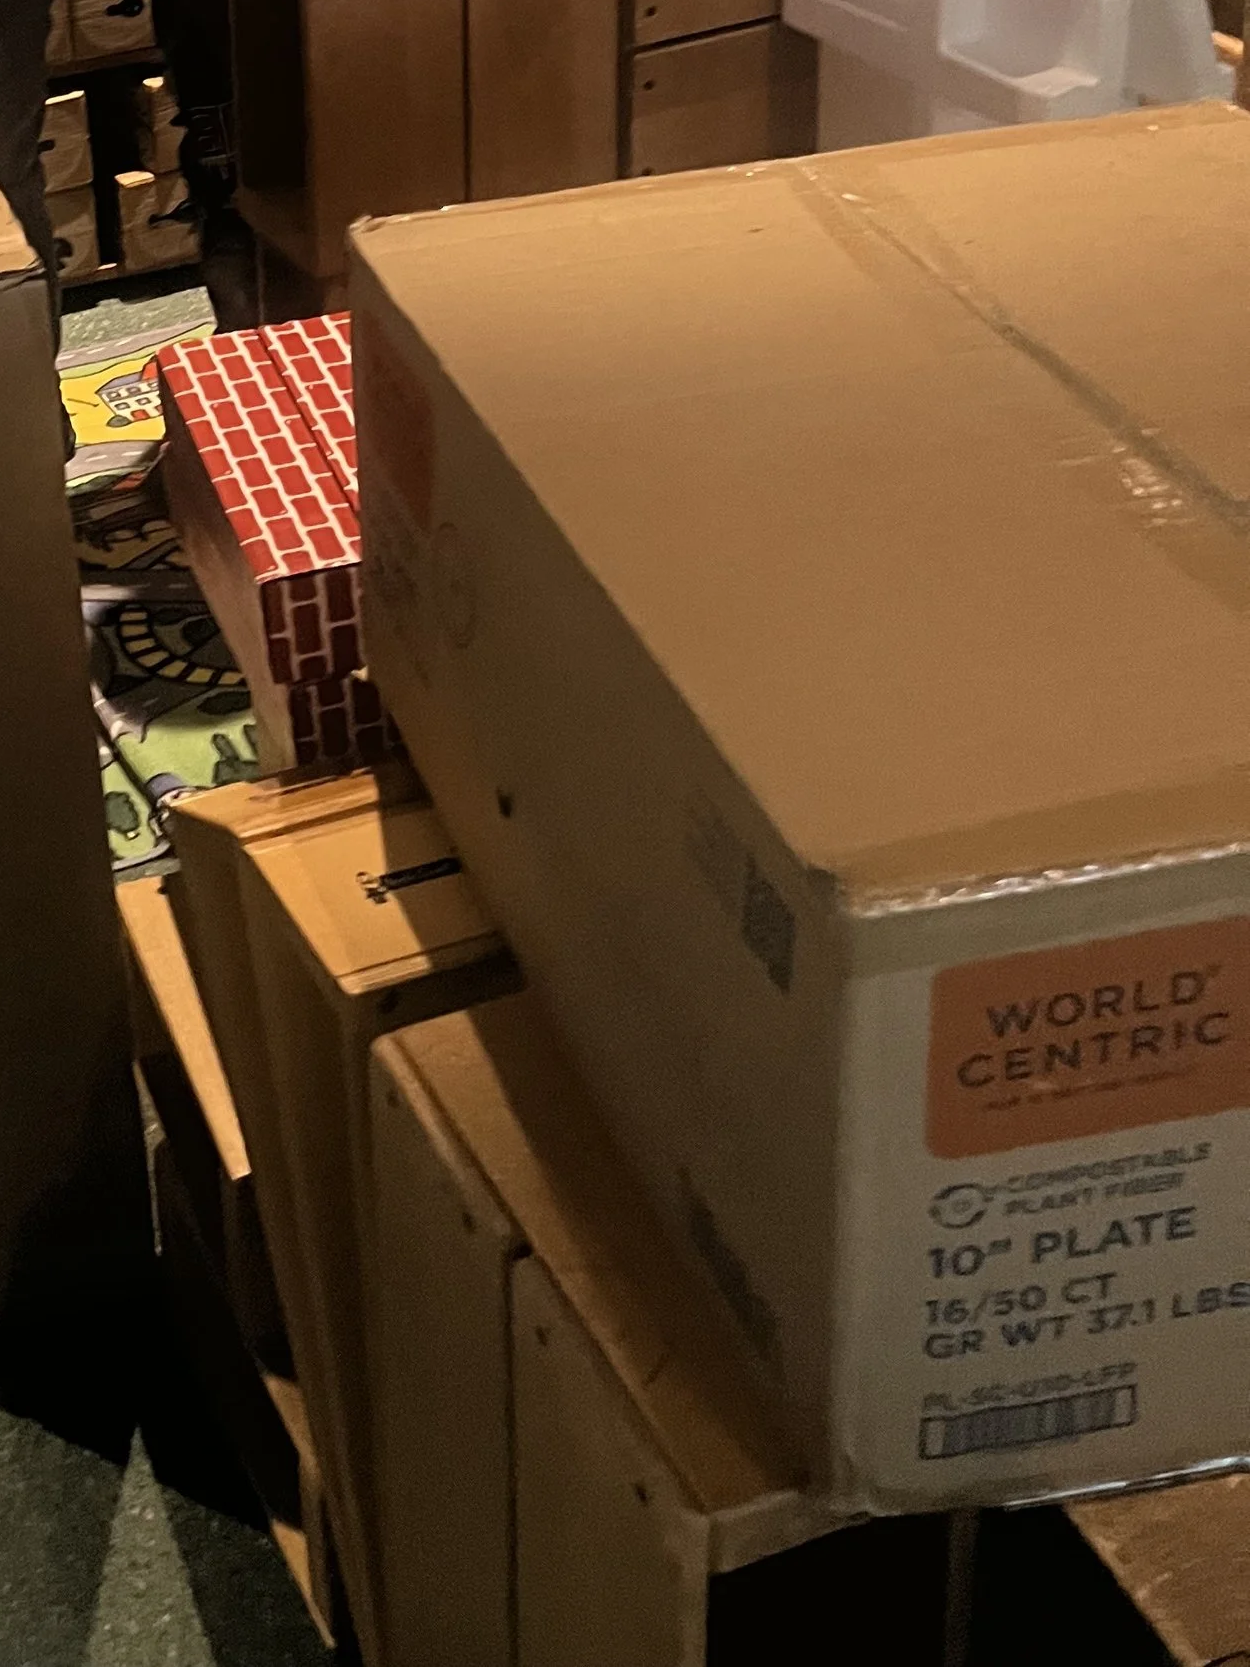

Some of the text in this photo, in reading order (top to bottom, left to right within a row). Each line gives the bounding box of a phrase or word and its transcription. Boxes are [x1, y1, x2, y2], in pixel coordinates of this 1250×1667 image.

[986, 970, 1206, 1038] WORLD
[956, 1011, 1230, 1088] CENTRIC
[928, 1205, 1198, 1279] 10" PLATE
[923, 1281, 1250, 1360] GR WT 37.1 LBS
[924, 1271, 1118, 1326] 16/50 CT
